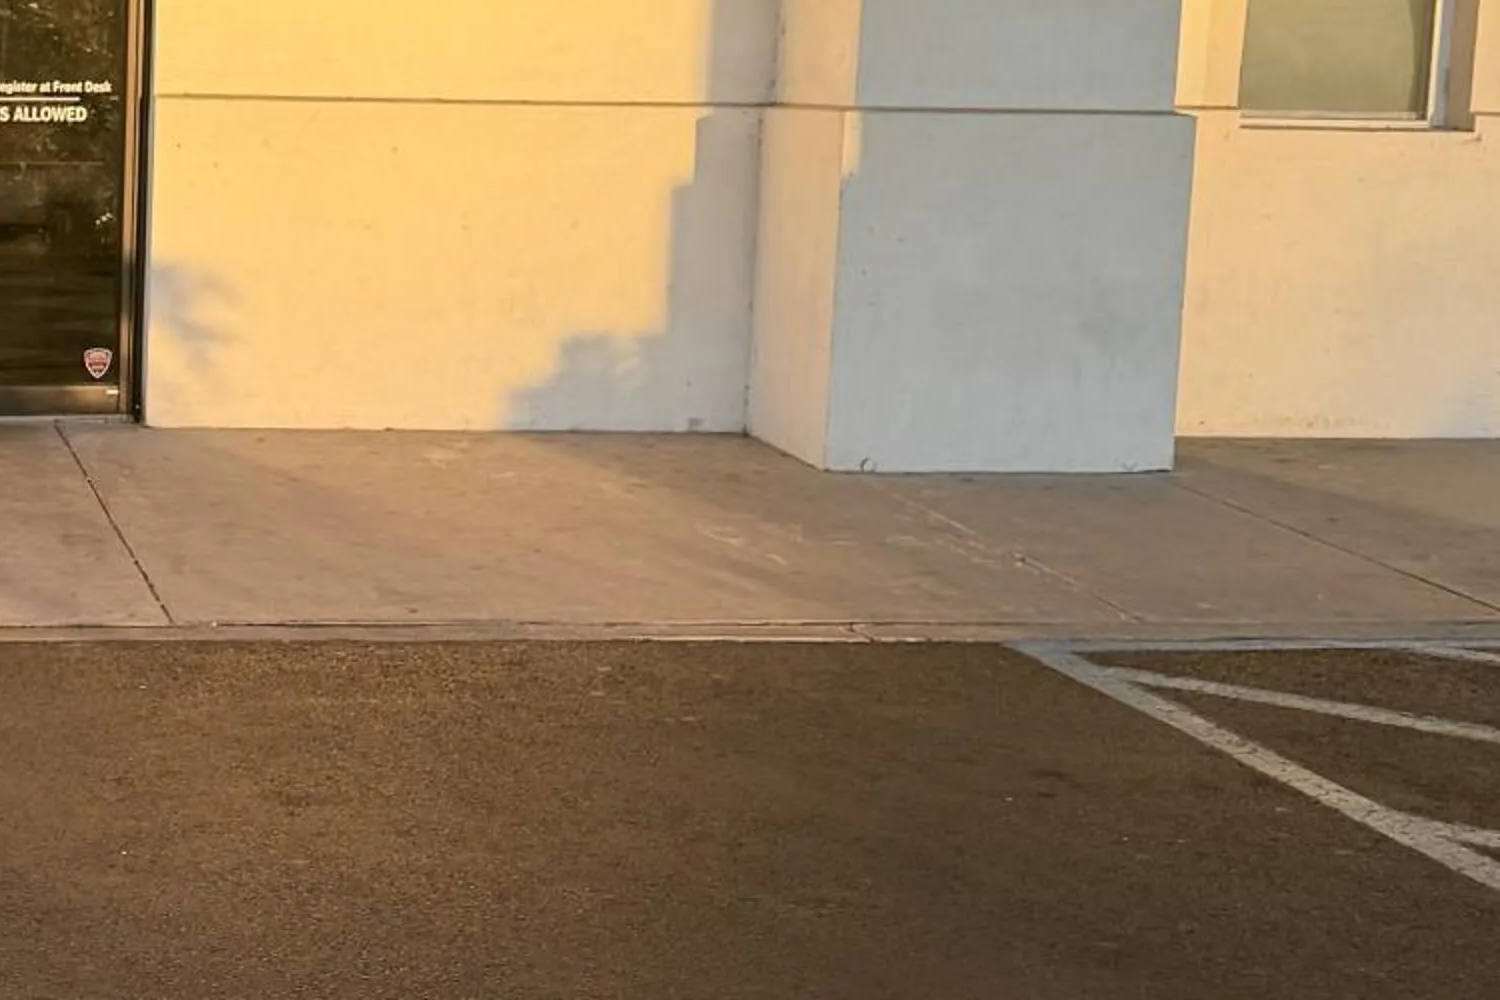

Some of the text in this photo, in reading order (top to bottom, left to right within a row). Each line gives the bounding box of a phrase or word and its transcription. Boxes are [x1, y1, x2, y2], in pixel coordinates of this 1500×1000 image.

[39, 80, 51, 93] at
[52, 79, 82, 93] Front
[84, 79, 112, 93] Desk
[12, 104, 88, 123] ALLOWED
